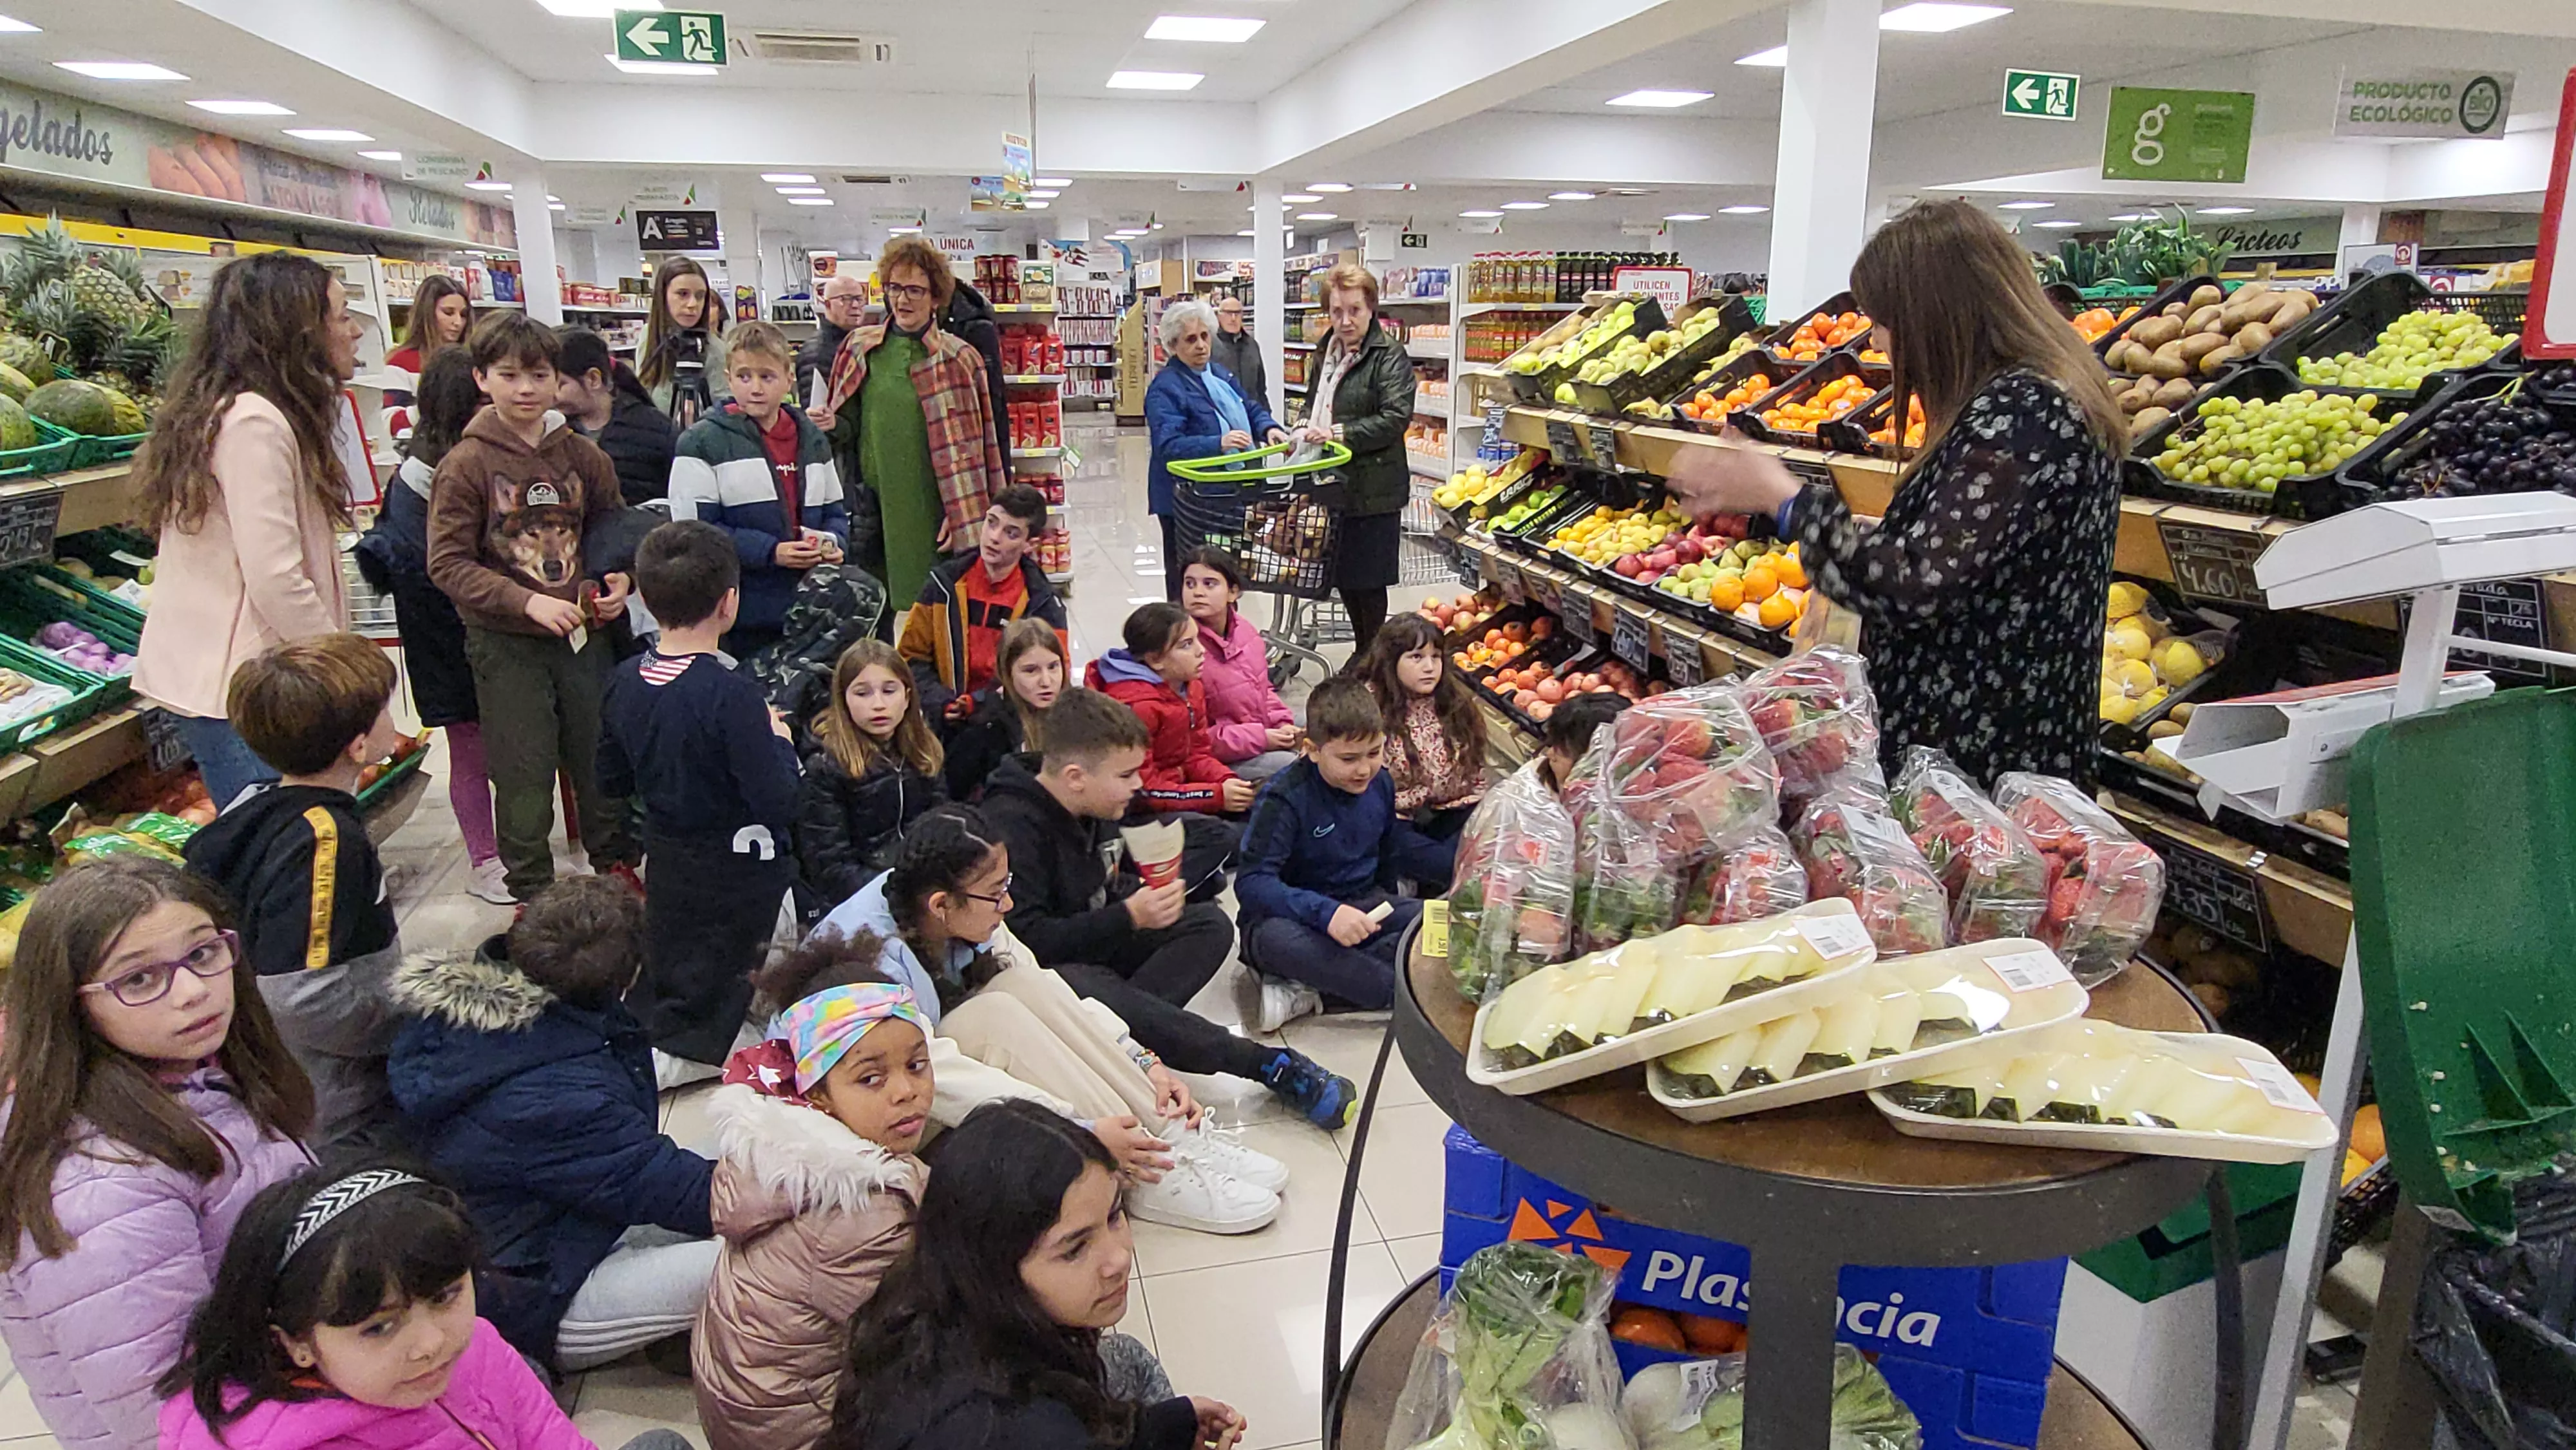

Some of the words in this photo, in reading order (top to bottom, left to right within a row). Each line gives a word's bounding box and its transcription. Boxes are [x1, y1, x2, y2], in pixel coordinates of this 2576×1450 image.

[2353, 82, 2451, 99] PRODUCTO
[2350, 102, 2453, 123] ECOLÓGICO
[1633, 281, 1671, 290] UTILICEN
[2502, 618, 2534, 629] TECLA
